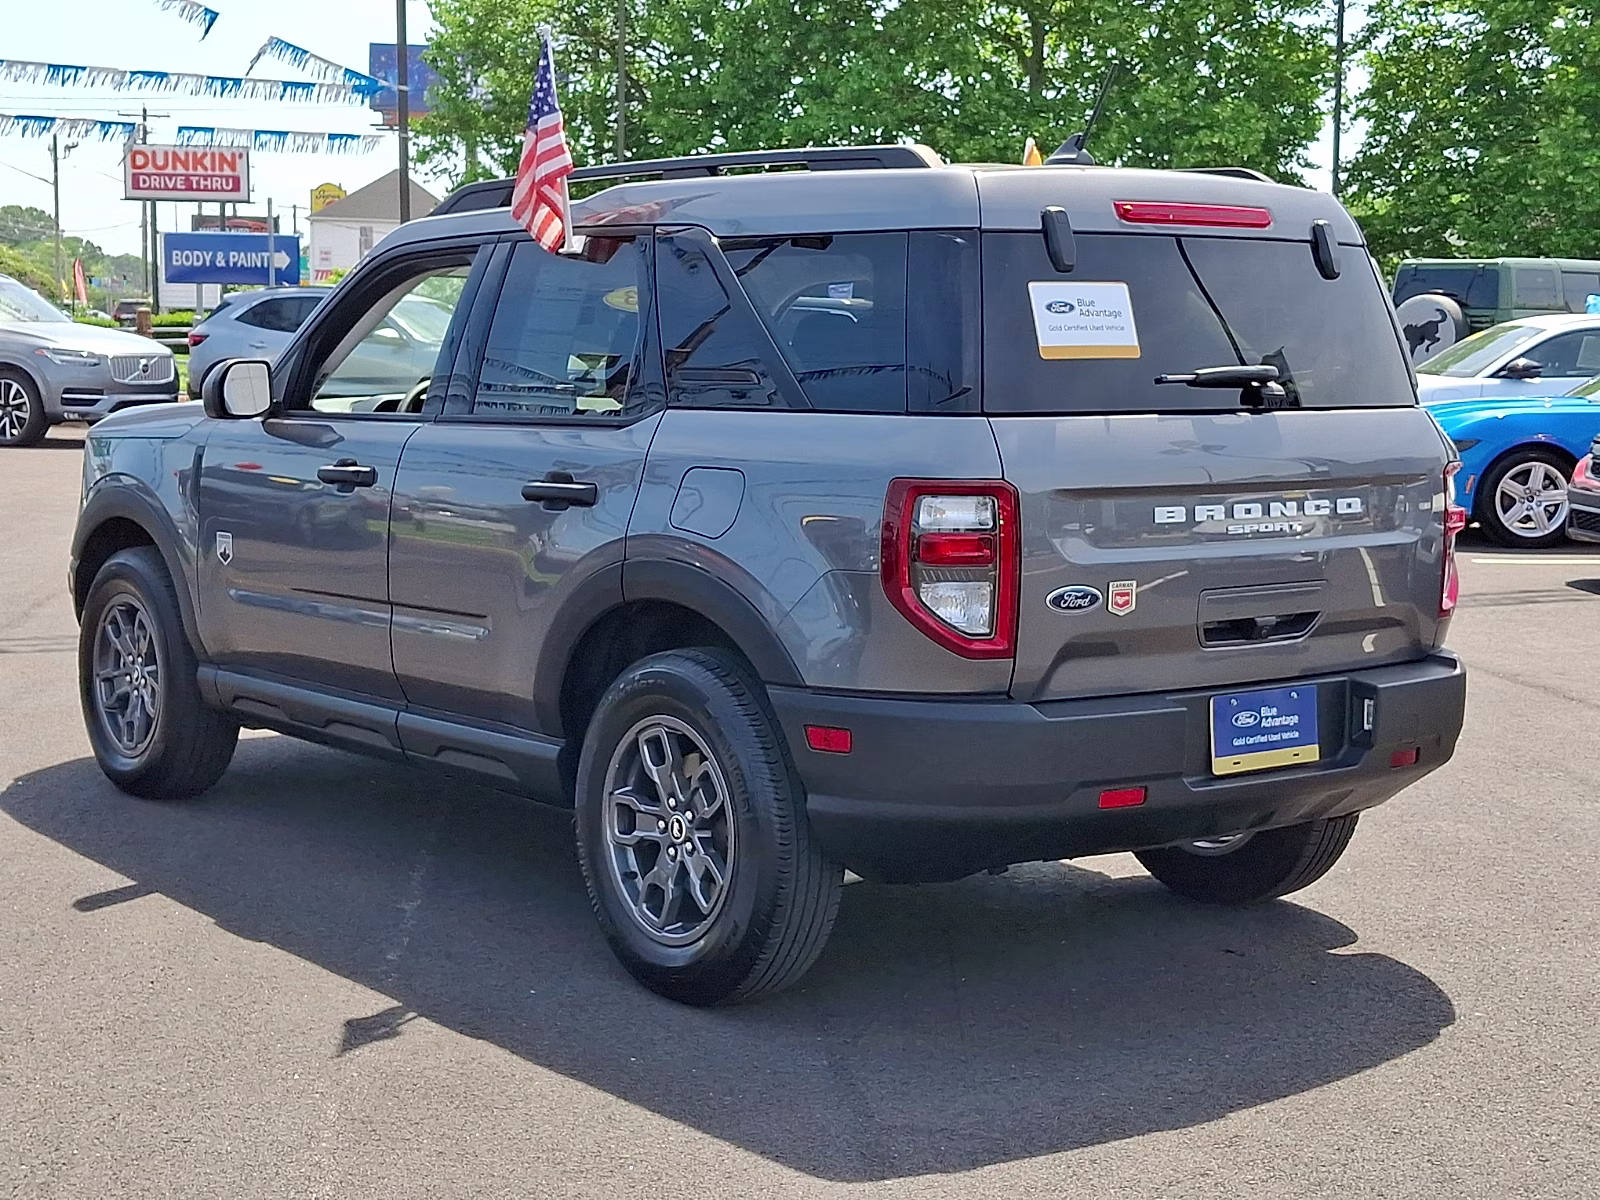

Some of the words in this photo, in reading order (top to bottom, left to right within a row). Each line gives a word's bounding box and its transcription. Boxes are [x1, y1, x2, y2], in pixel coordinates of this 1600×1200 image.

[130, 149, 244, 173] DUNKIN'
[139, 175, 186, 190] DRIVE
[189, 176, 233, 191] THRU
[172, 250, 212, 267] BODY
[215, 251, 226, 267] &
[229, 251, 271, 268] PAINT
[1076, 298, 1096, 308] Blue
[1079, 308, 1122, 319] Advantage
[1048, 324, 1063, 332] Gold
[1063, 324, 1088, 332] Certified
[1089, 324, 1104, 332] Used
[1154, 497, 1363, 524] BRONCO
[1227, 521, 1302, 535] SPORT
[1060, 591, 1092, 608] Ford
[1260, 706, 1277, 717] Blue
[1261, 714, 1299, 728] Advantage
[1232, 736, 1246, 746] Gold
[1246, 734, 1268, 745] Certified
[1268, 732, 1281, 742] Used
[1282, 730, 1299, 740] Vehicle
